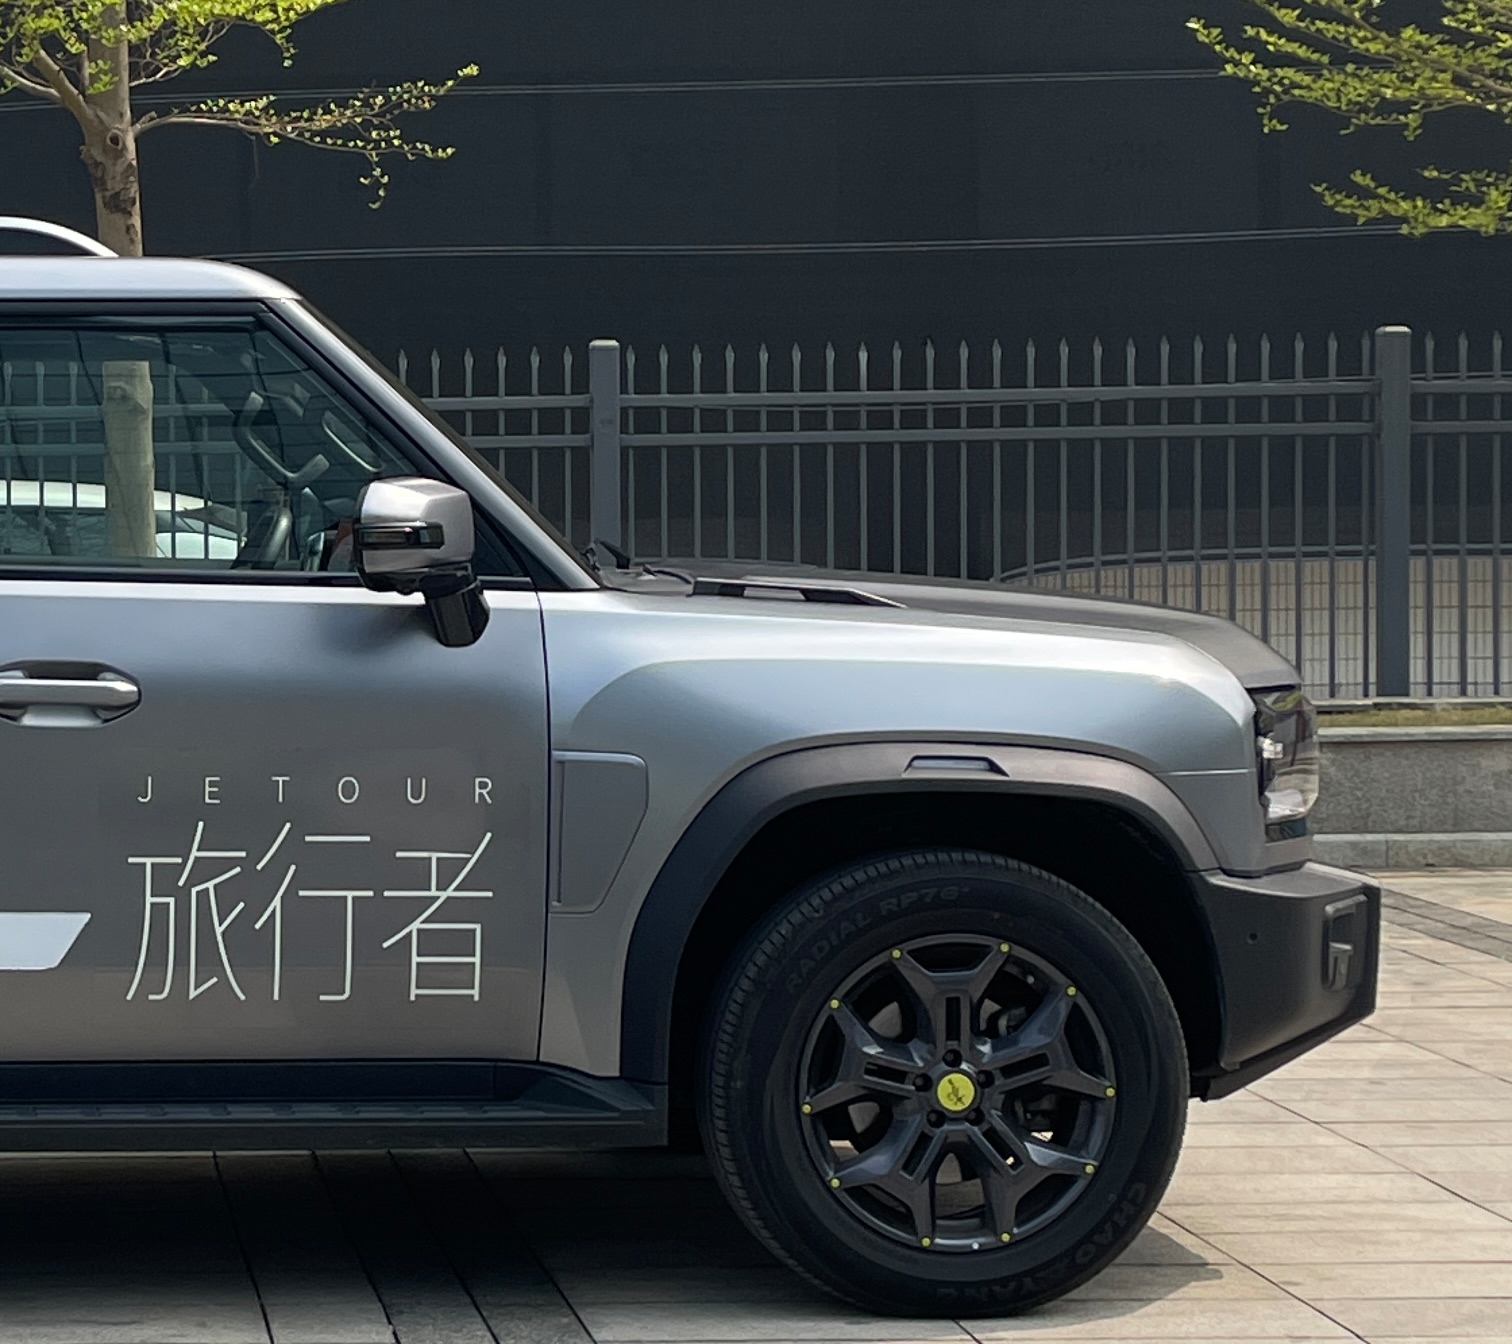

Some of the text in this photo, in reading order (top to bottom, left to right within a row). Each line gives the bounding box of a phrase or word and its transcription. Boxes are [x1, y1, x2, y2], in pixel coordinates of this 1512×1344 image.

[137, 776, 493, 805] JETOUR
[125, 820, 494, 1002] 旅行者
[786, 912, 873, 994] RADIAL
